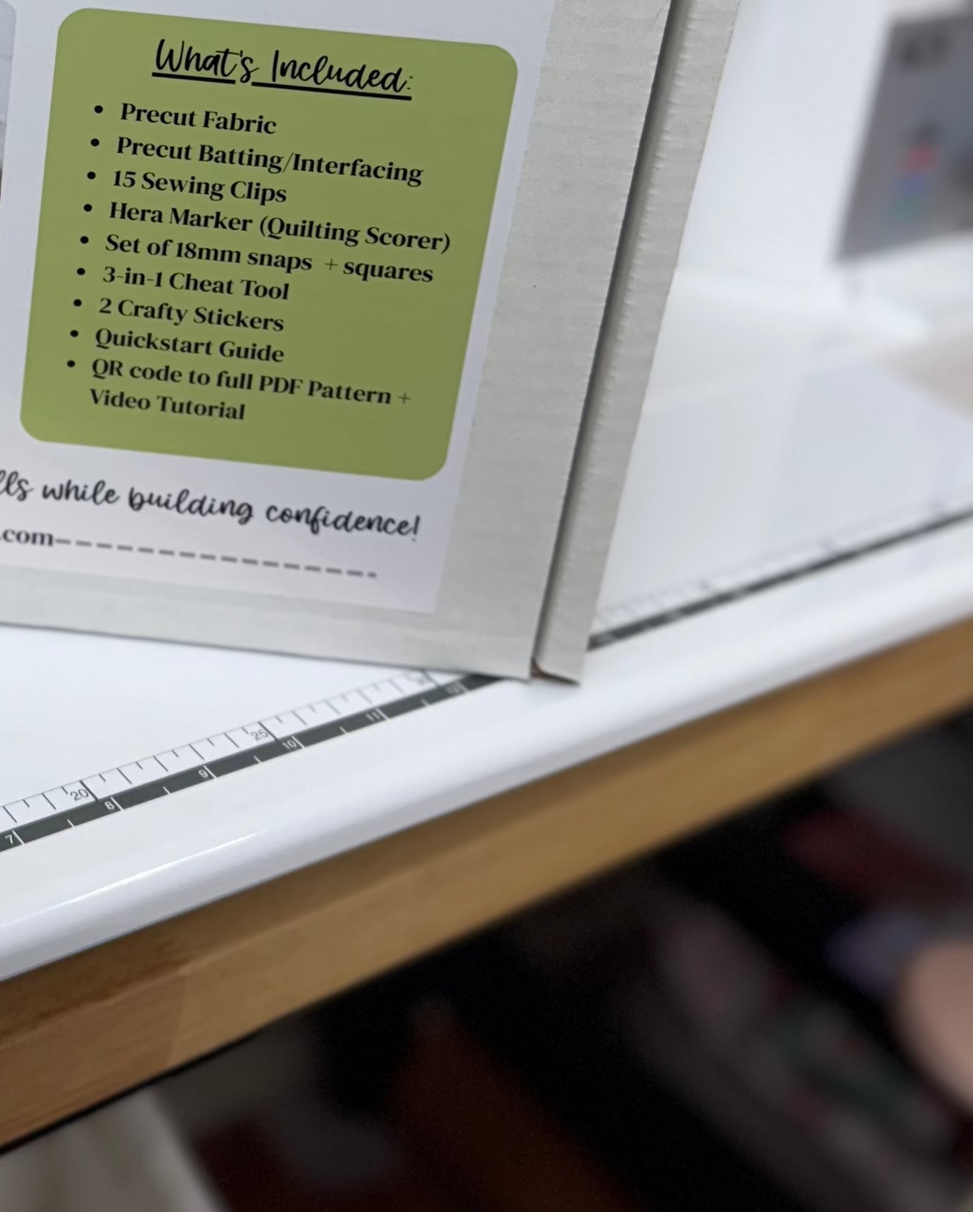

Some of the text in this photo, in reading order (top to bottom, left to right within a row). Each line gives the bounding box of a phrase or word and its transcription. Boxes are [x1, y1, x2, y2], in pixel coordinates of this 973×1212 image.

[155, 38, 413, 93] What's Included:
[121, 102, 277, 134] Precut Fabric
[117, 136, 424, 188] Precut Batting/Interfacing
[113, 170, 287, 206] 15 Sewing Clips
[109, 201, 450, 254] Hera Marker (Quilting Scorer)
[105, 234, 433, 282] Set of 18mm snaps + squares
[103, 266, 289, 300] 3-in-1 Cheat Tool
[99, 298, 285, 332] 2 Crafty Stickers
[95, 328, 285, 363] Quickstart Guide
[92, 358, 411, 404] QR code to full PDF Pattern +
[90, 388, 245, 420] Video Tutorial
[41, 479, 120, 505] while
[127, 487, 254, 525] building
[265, 504, 421, 542] confidence!
[250, 727, 269, 741] 25
[282, 739, 297, 751] 10
[198, 769, 209, 780] 9
[70, 787, 89, 802] 20
[104, 800, 115, 811] 8
[4, 834, 14, 846] 7
